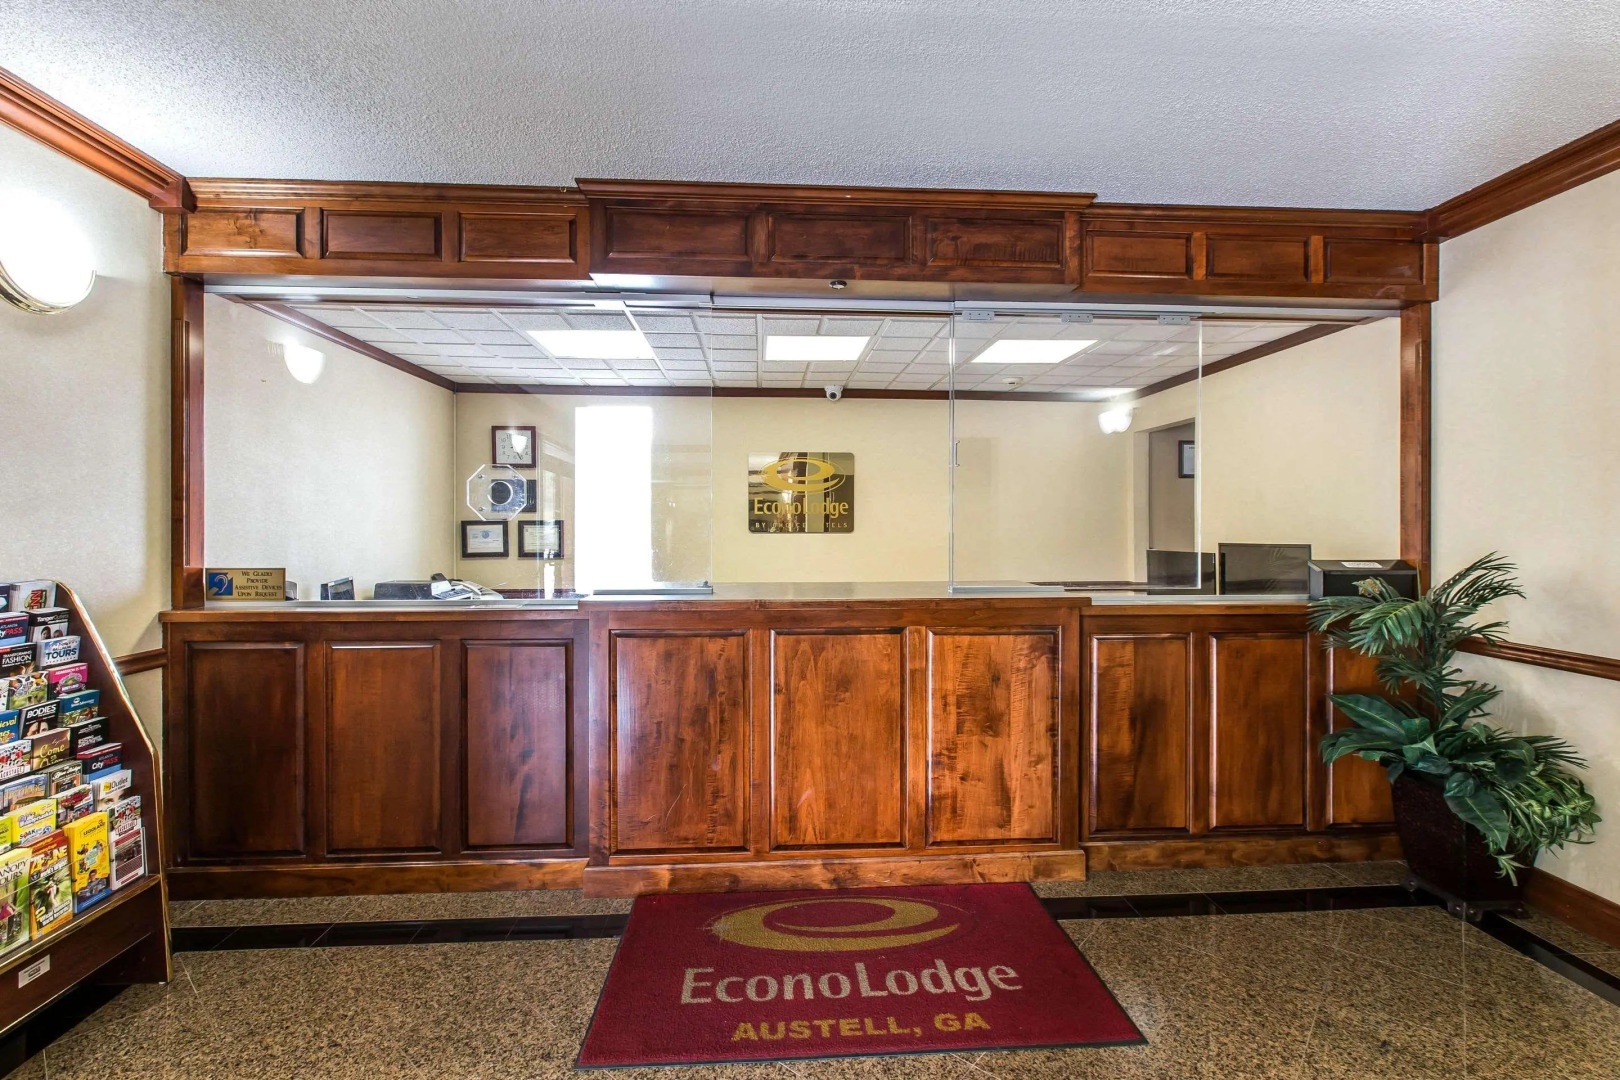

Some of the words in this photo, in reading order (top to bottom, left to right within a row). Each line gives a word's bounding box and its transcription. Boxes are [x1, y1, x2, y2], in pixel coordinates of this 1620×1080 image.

[2, 654, 32, 665] FASHION
[45, 648, 78, 661] TOURS
[27, 704, 57, 719] BODIES
[40, 744, 65, 758] Come
[111, 777, 128, 789] Outlet
[732, 1016, 923, 1041] AUSTELL,
[935, 1011, 991, 1032] GA
